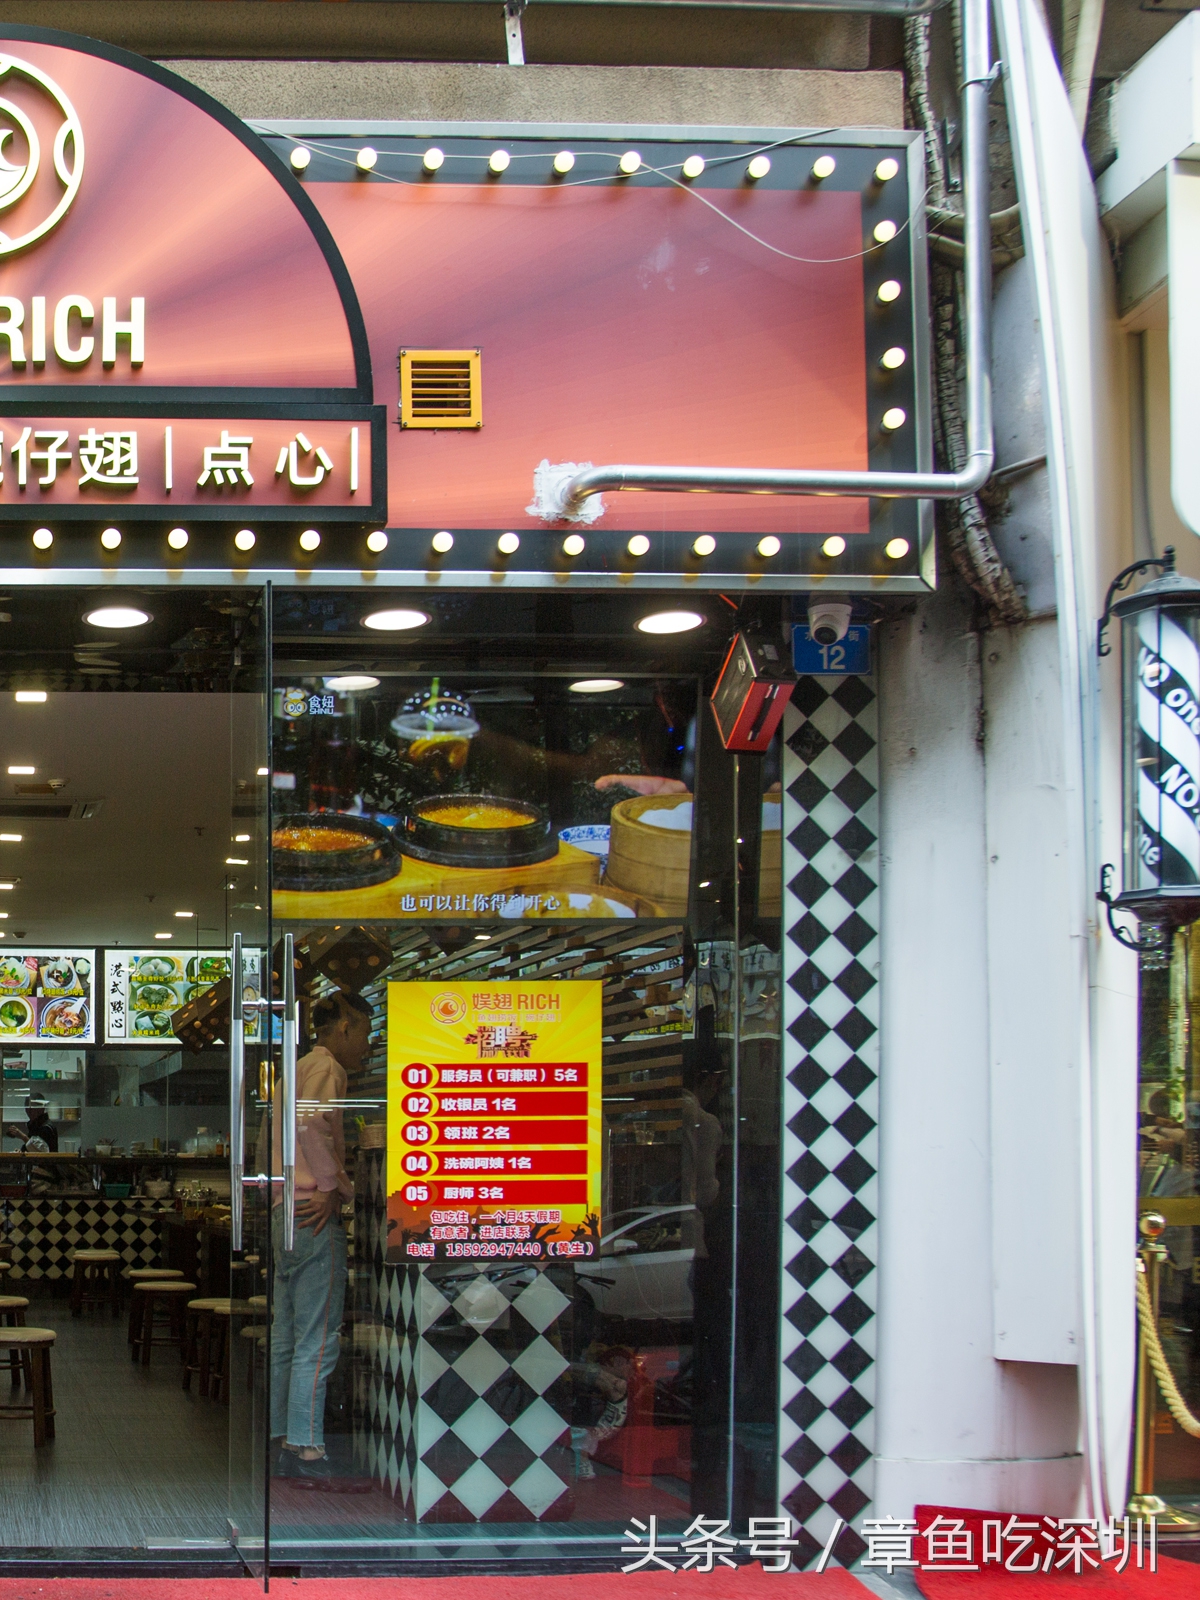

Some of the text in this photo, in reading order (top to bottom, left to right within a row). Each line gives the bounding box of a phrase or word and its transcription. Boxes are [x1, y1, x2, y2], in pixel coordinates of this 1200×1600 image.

[196, 429, 335, 488] 点心
[818, 645, 846, 670] 12
[308, 694, 335, 709] 食妞
[399, 893, 561, 912] 也可以让你得到开心
[472, 992, 560, 1011] 娱翅 RICH
[477, 1023, 537, 1049] 招聘
[407, 1068, 427, 1084] 01
[407, 1097, 429, 1113] 02
[441, 1097, 488, 1112] 收银员
[406, 1126, 428, 1141] 03
[443, 1126, 478, 1141] 领班
[406, 1157, 428, 1172] 04
[443, 1156, 505, 1171] 洗碗阿姨
[406, 1186, 428, 1201] 05
[443, 1186, 474, 1200] 厨师
[431, 1226, 531, 1240] 有意者，进店联系
[407, 1243, 435, 1257] 电话
